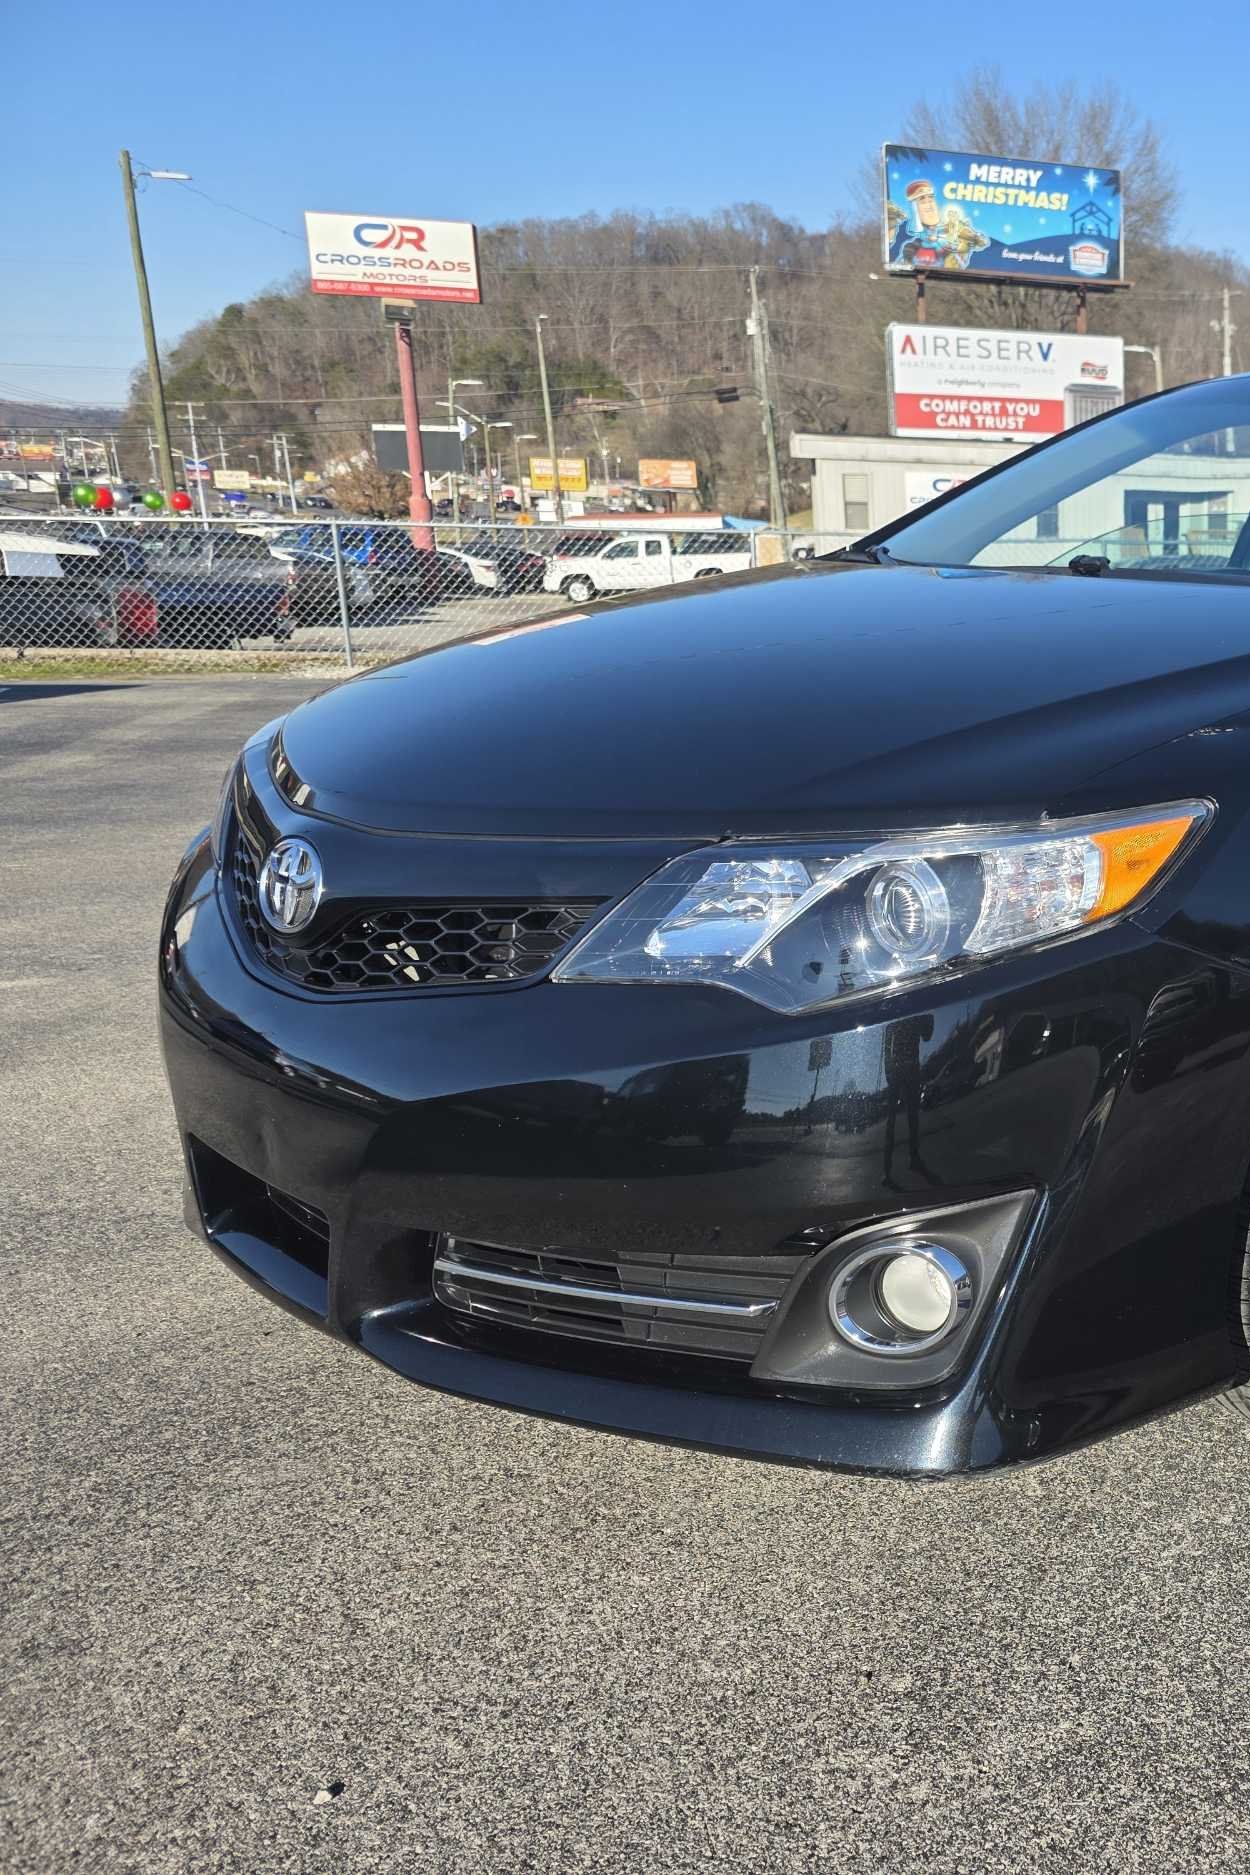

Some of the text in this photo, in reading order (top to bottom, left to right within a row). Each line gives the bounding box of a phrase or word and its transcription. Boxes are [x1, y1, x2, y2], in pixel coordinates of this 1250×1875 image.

[969, 163, 1043, 188] MERRY
[943, 181, 1070, 212] CHRISTMAS!
[315, 253, 471, 273] CROSSROADS
[361, 271, 429, 283] MOTORS
[899, 334, 1054, 363] AIRESERV
[919, 398, 1041, 417] COMFORT YOU
[935, 412, 1025, 430] CAN TRUST
